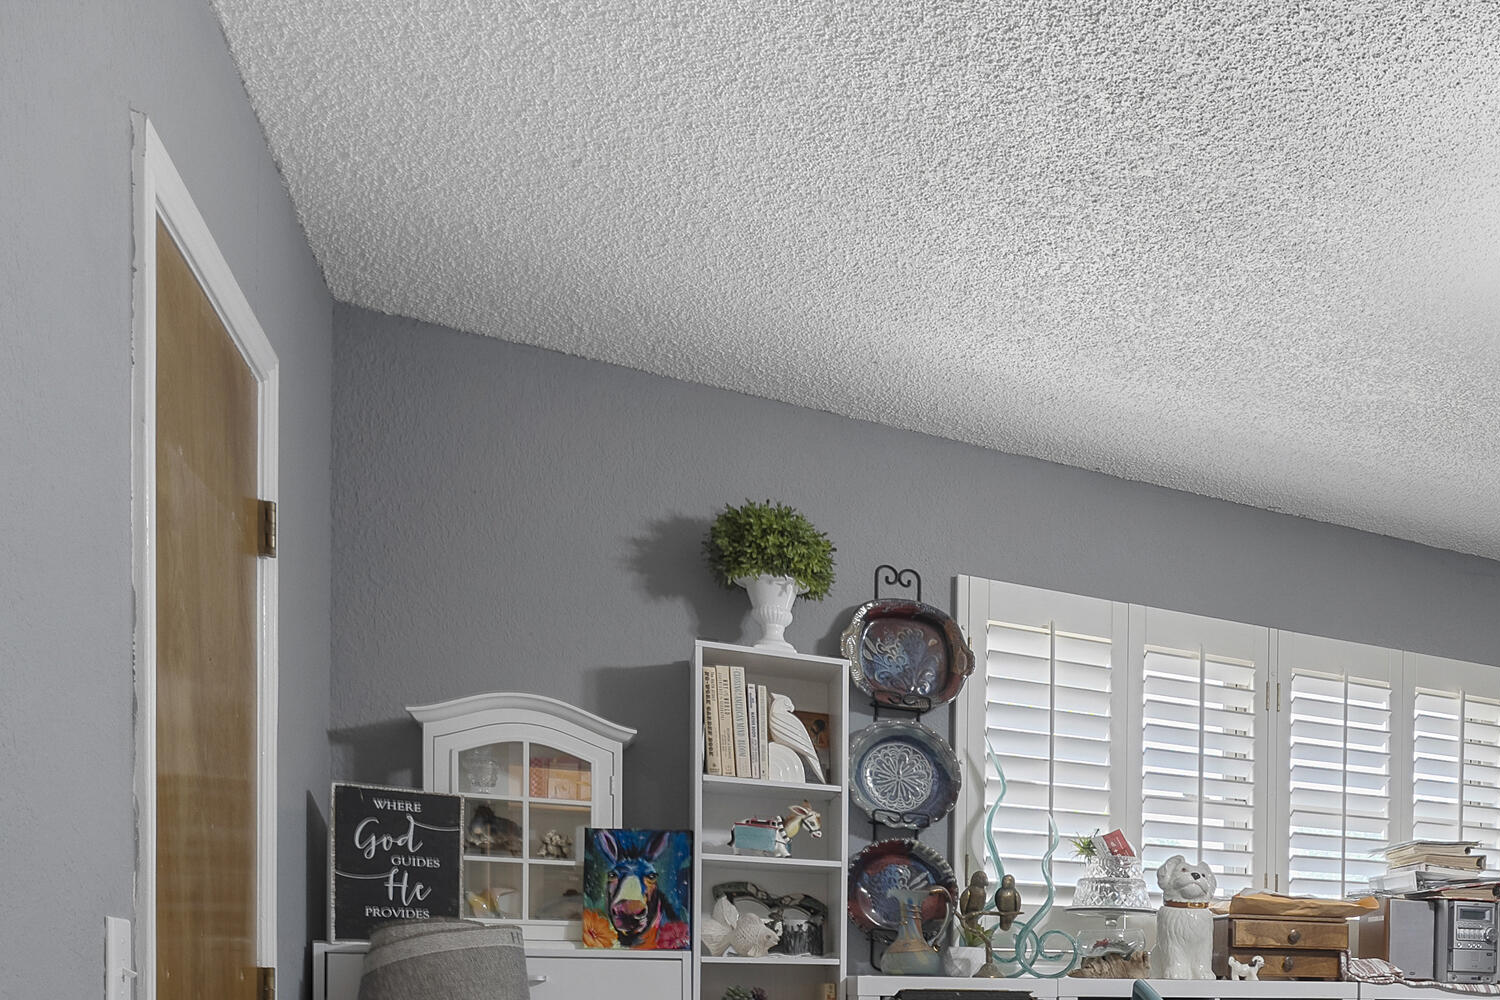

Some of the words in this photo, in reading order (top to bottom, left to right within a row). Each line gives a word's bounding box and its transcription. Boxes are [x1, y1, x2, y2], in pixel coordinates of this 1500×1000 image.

[373, 798, 422, 813] WHERE
[355, 813, 432, 859] God
[391, 855, 441, 868] GUIDES
[376, 867, 432, 906] He
[365, 905, 430, 919] PROVIDES
